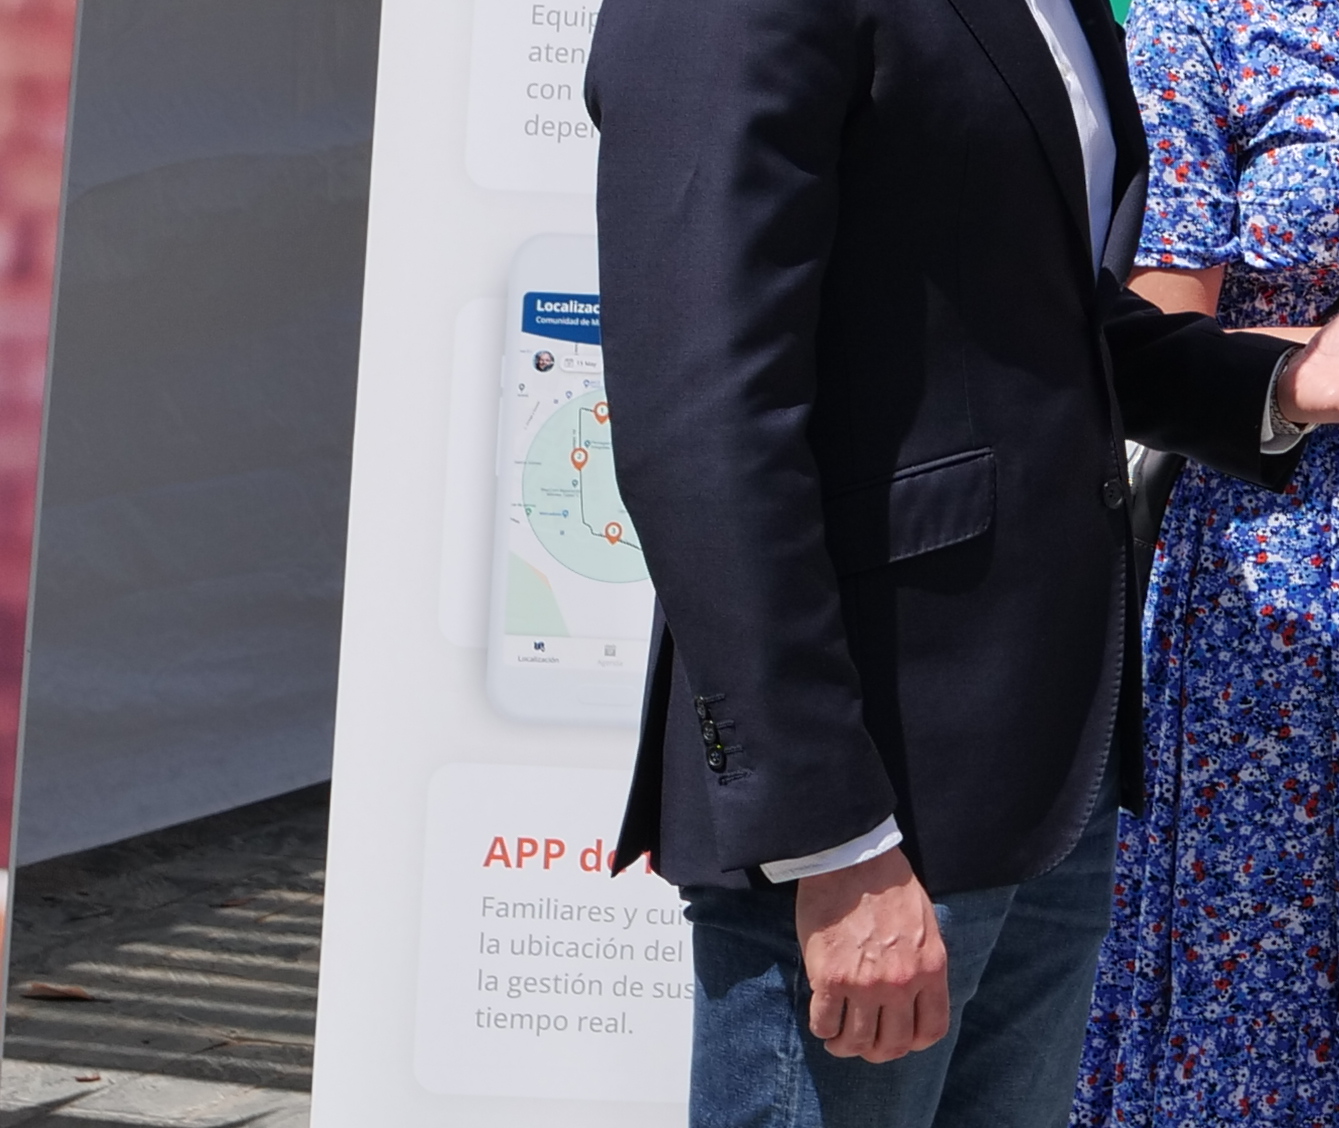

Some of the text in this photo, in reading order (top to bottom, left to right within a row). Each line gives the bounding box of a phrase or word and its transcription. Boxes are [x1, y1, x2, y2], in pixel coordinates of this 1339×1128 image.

[528, 42, 586, 65] aten
[525, 81, 573, 102] con
[535, 315, 579, 327] Comunidad
[580, 317, 591, 327] de
[482, 835, 566, 871] APP
[481, 895, 694, 930] Familiares y cui
[478, 931, 684, 964] la ubicación del
[476, 968, 695, 1001] la gestión de sus
[475, 1006, 634, 1037] tiempo real.
